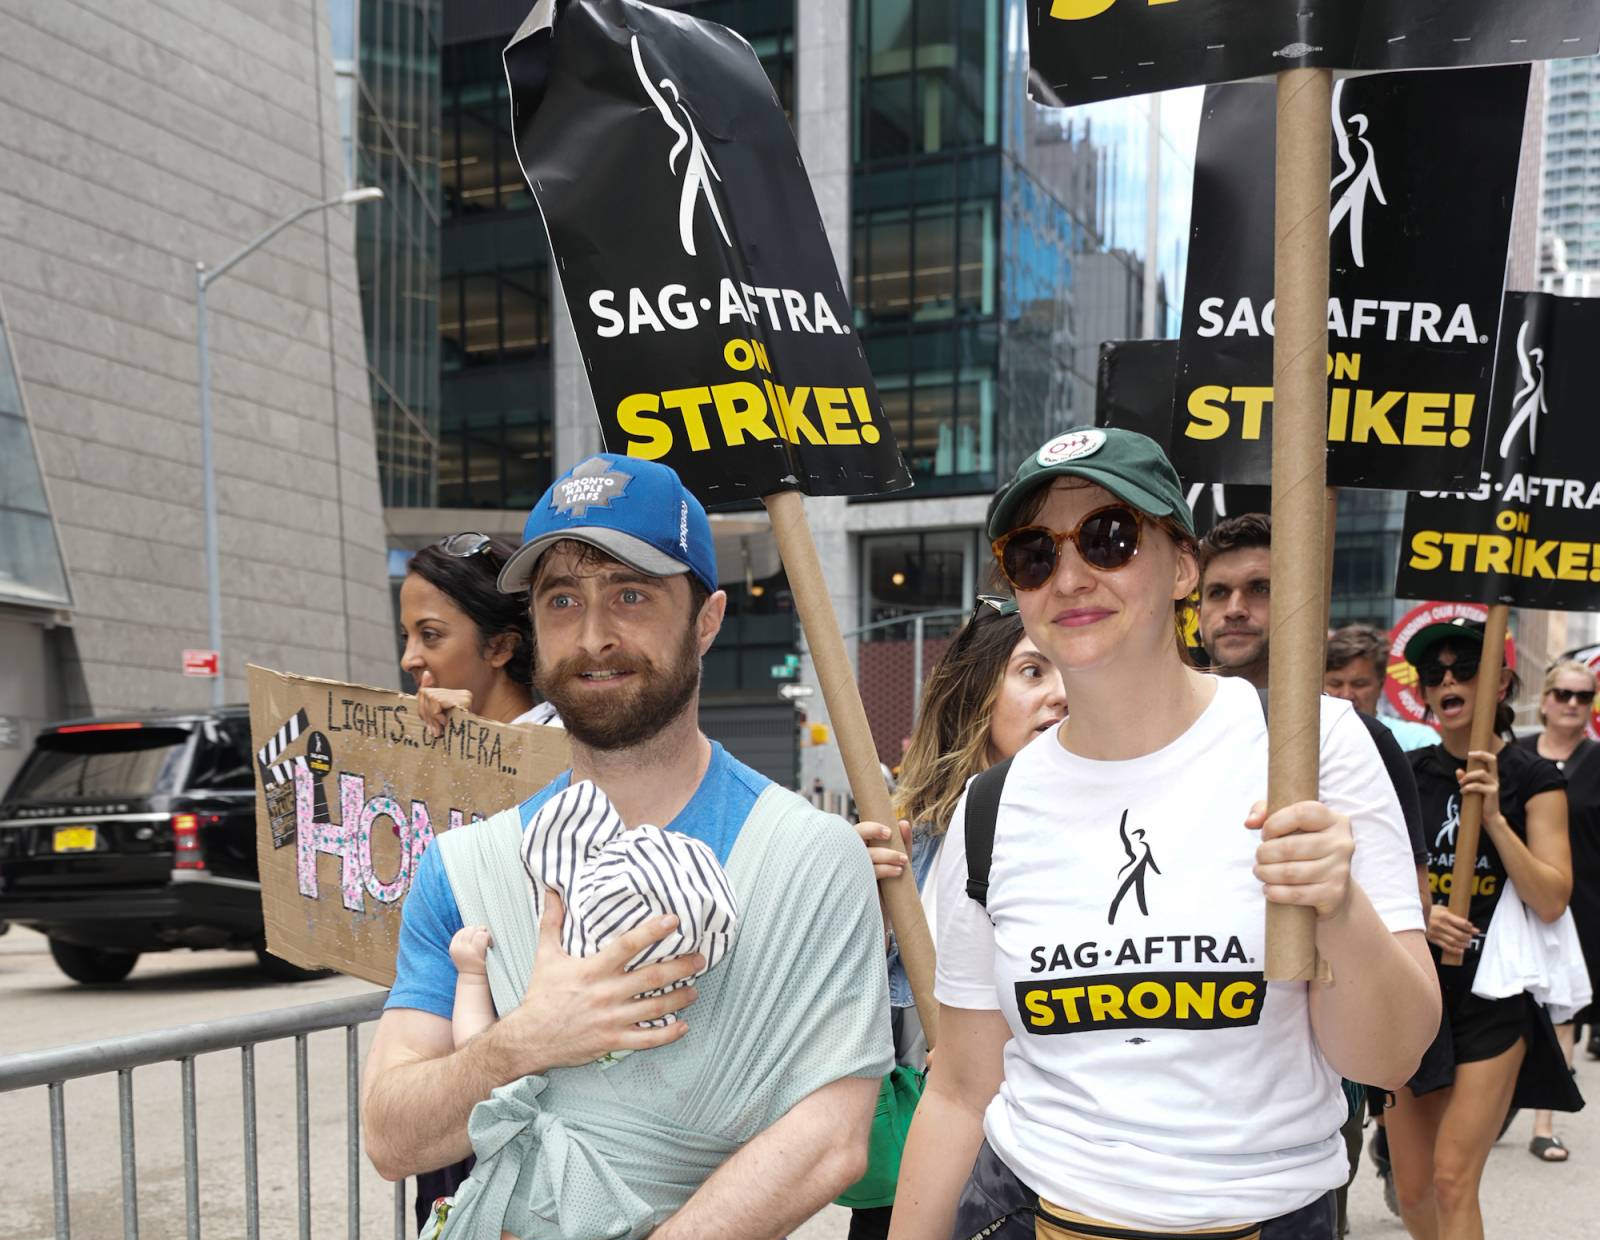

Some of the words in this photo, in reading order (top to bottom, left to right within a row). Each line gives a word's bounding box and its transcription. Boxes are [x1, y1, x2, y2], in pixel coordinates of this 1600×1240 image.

[723, 338, 771, 373] ON
[616, 379, 880, 461] STRIKE!
[1184, 385, 1476, 448] STIKE!
[561, 476, 614, 492] TORONTO
[565, 484, 603, 497] MAPLE
[567, 492, 599, 504] LEAFS
[1496, 510, 1530, 533] ON
[1409, 530, 1600, 582] STRIKE!
[1024, 980, 1258, 1027] STRONG
